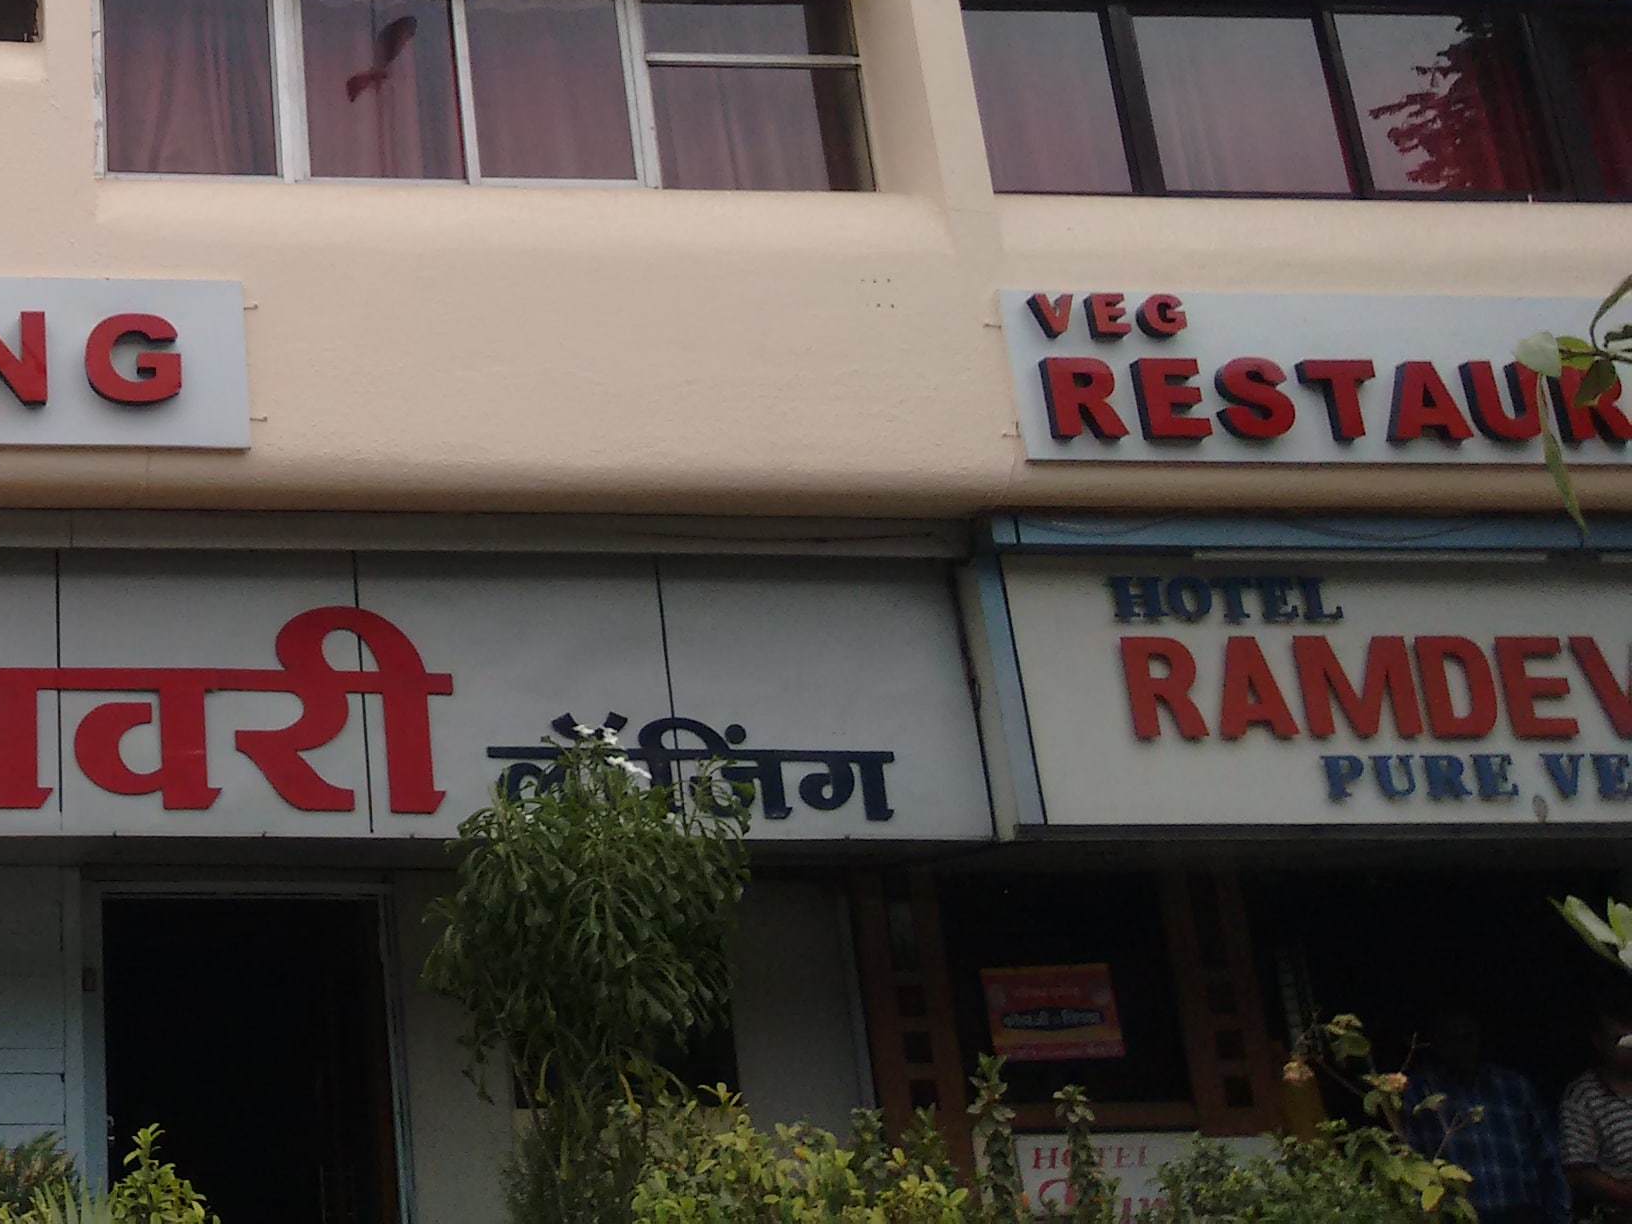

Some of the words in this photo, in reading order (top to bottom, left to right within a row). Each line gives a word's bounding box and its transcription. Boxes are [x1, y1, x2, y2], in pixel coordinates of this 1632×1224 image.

[1026, 292, 1188, 339] VEG
[1106, 576, 1344, 623] HOTEL
[1320, 753, 1518, 801] PURE
